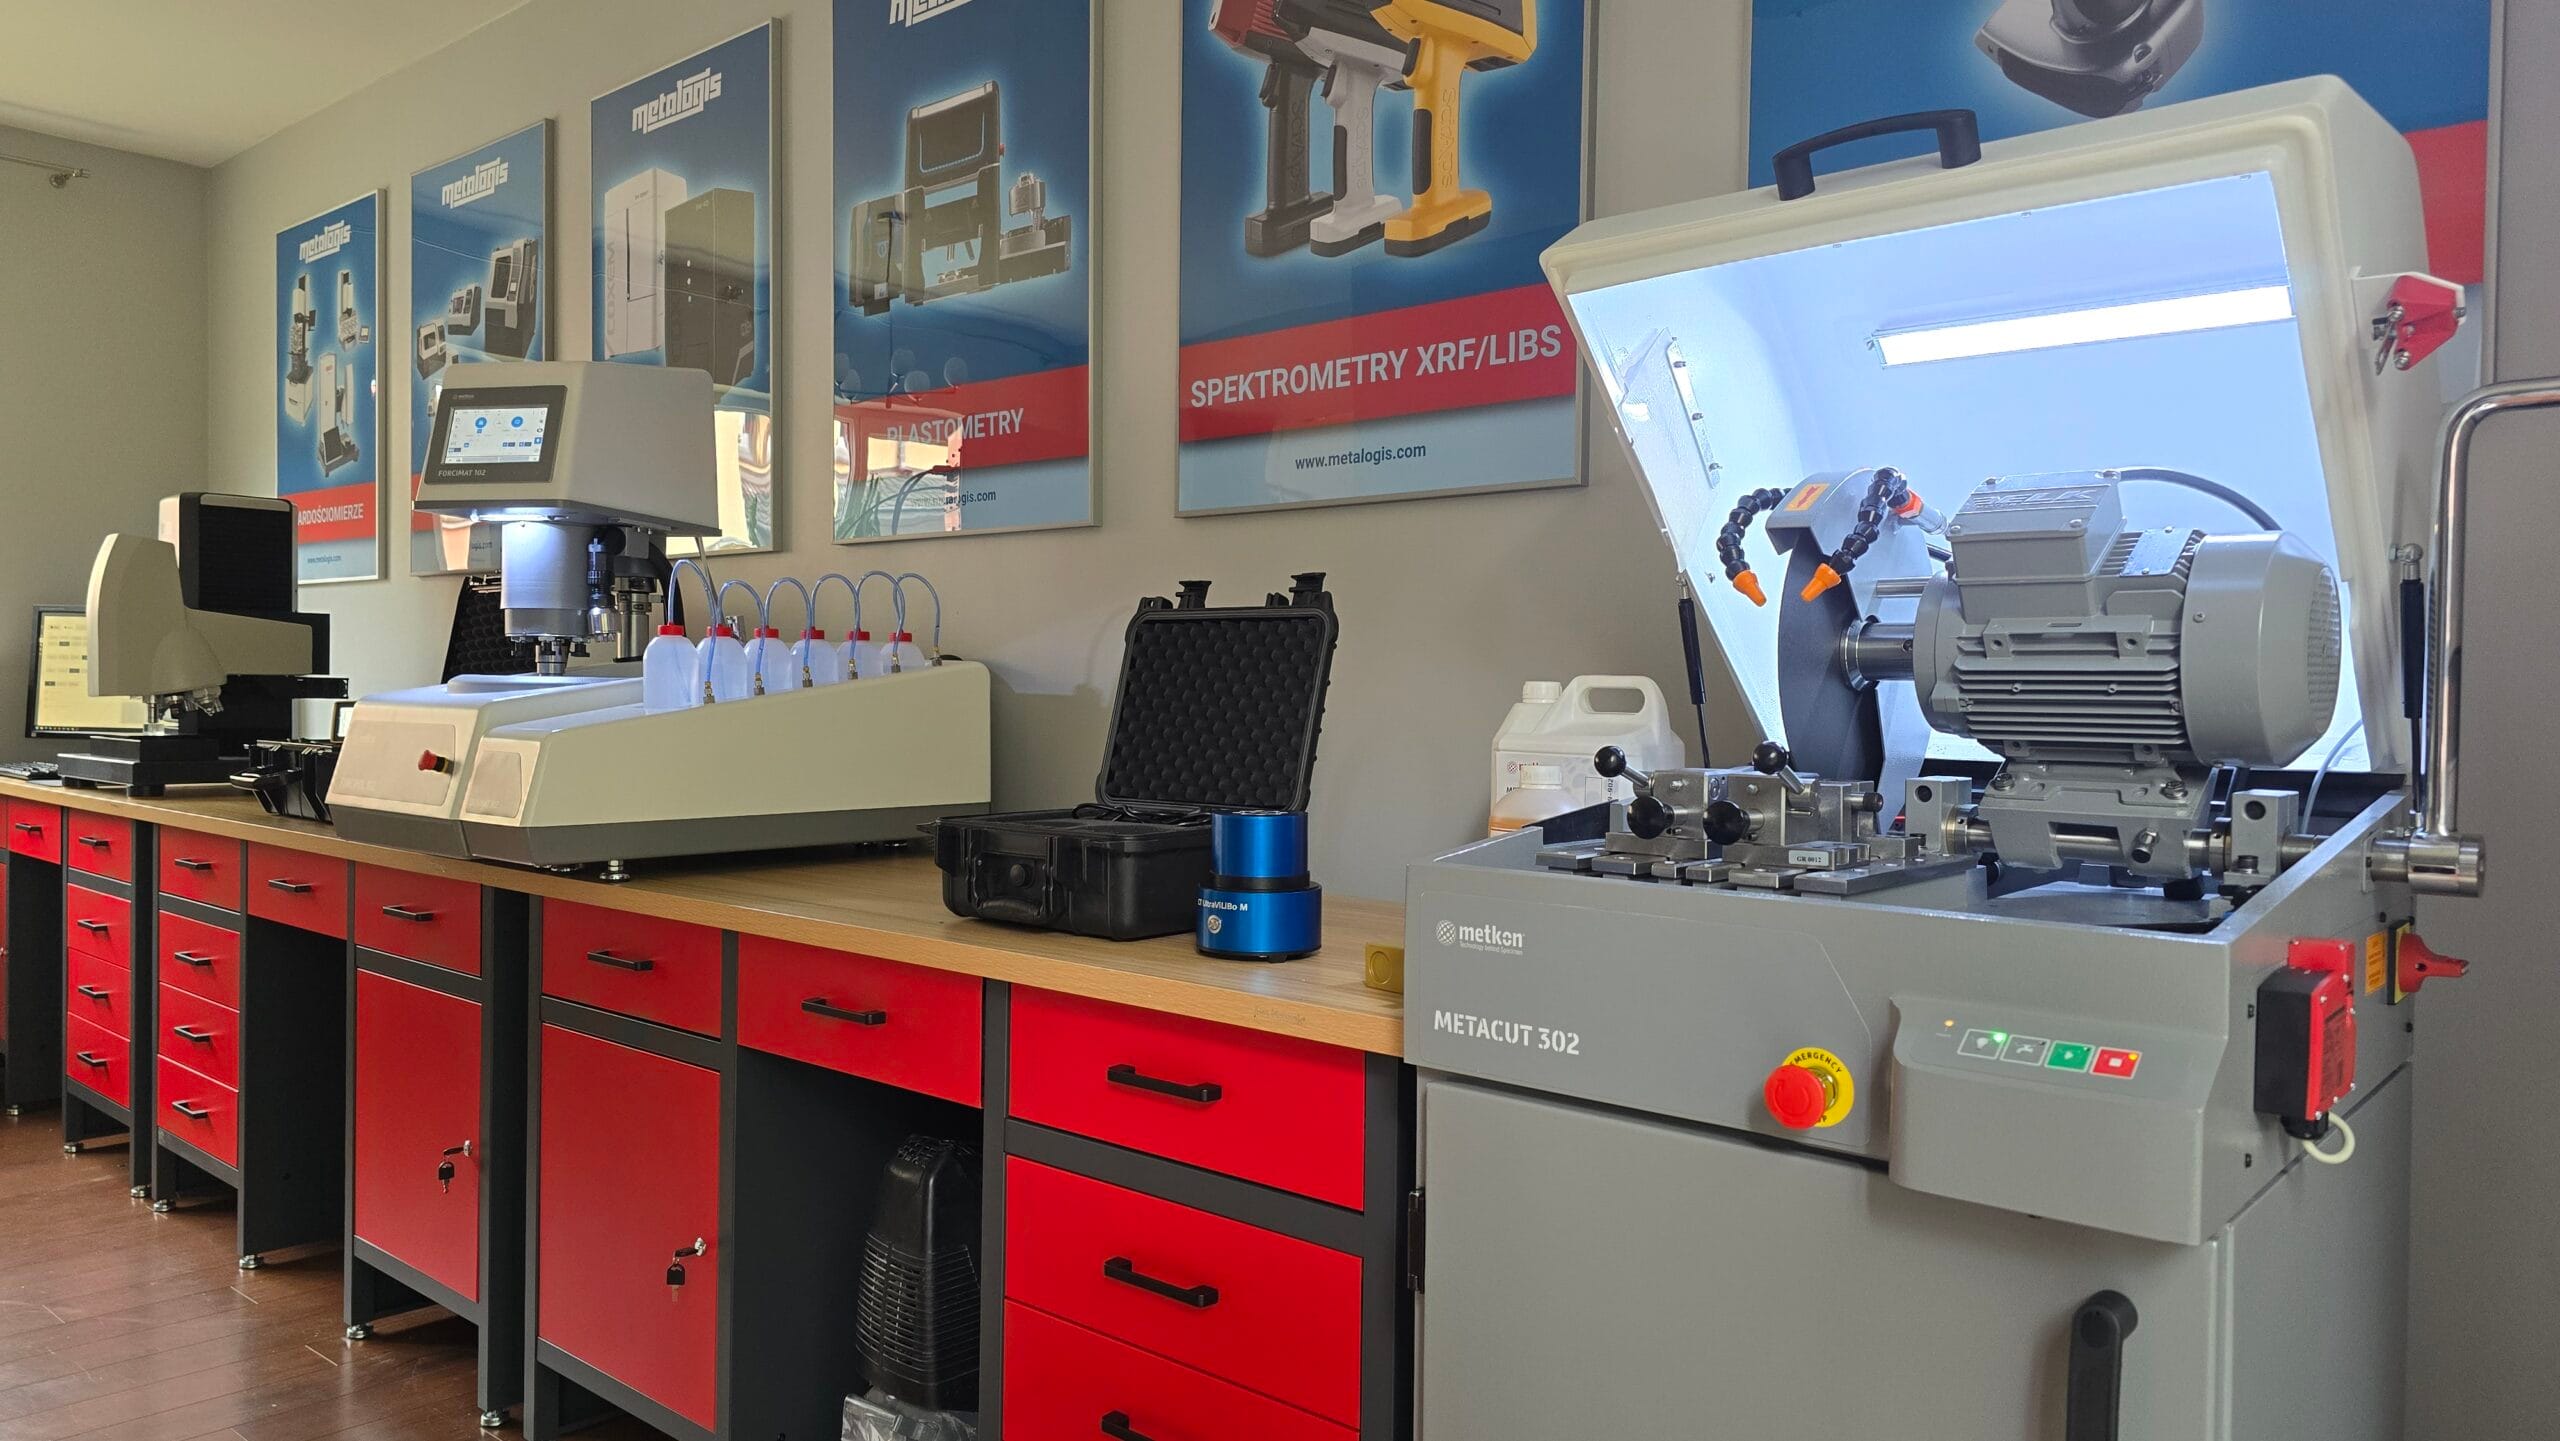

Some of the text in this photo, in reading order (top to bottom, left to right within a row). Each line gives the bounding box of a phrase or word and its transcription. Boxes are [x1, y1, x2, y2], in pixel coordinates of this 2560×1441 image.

[1190, 324, 1562, 408] SPEKTROMETRY XRF/LIBS
[1295, 443, 1426, 471] www.metalogis.com
[297, 503, 364, 526] ARDOŚCIOMIERZE
[1239, 903, 1248, 911] M
[1459, 924, 1523, 948] metkon
[1434, 1010, 1580, 1056] METACUT 302
